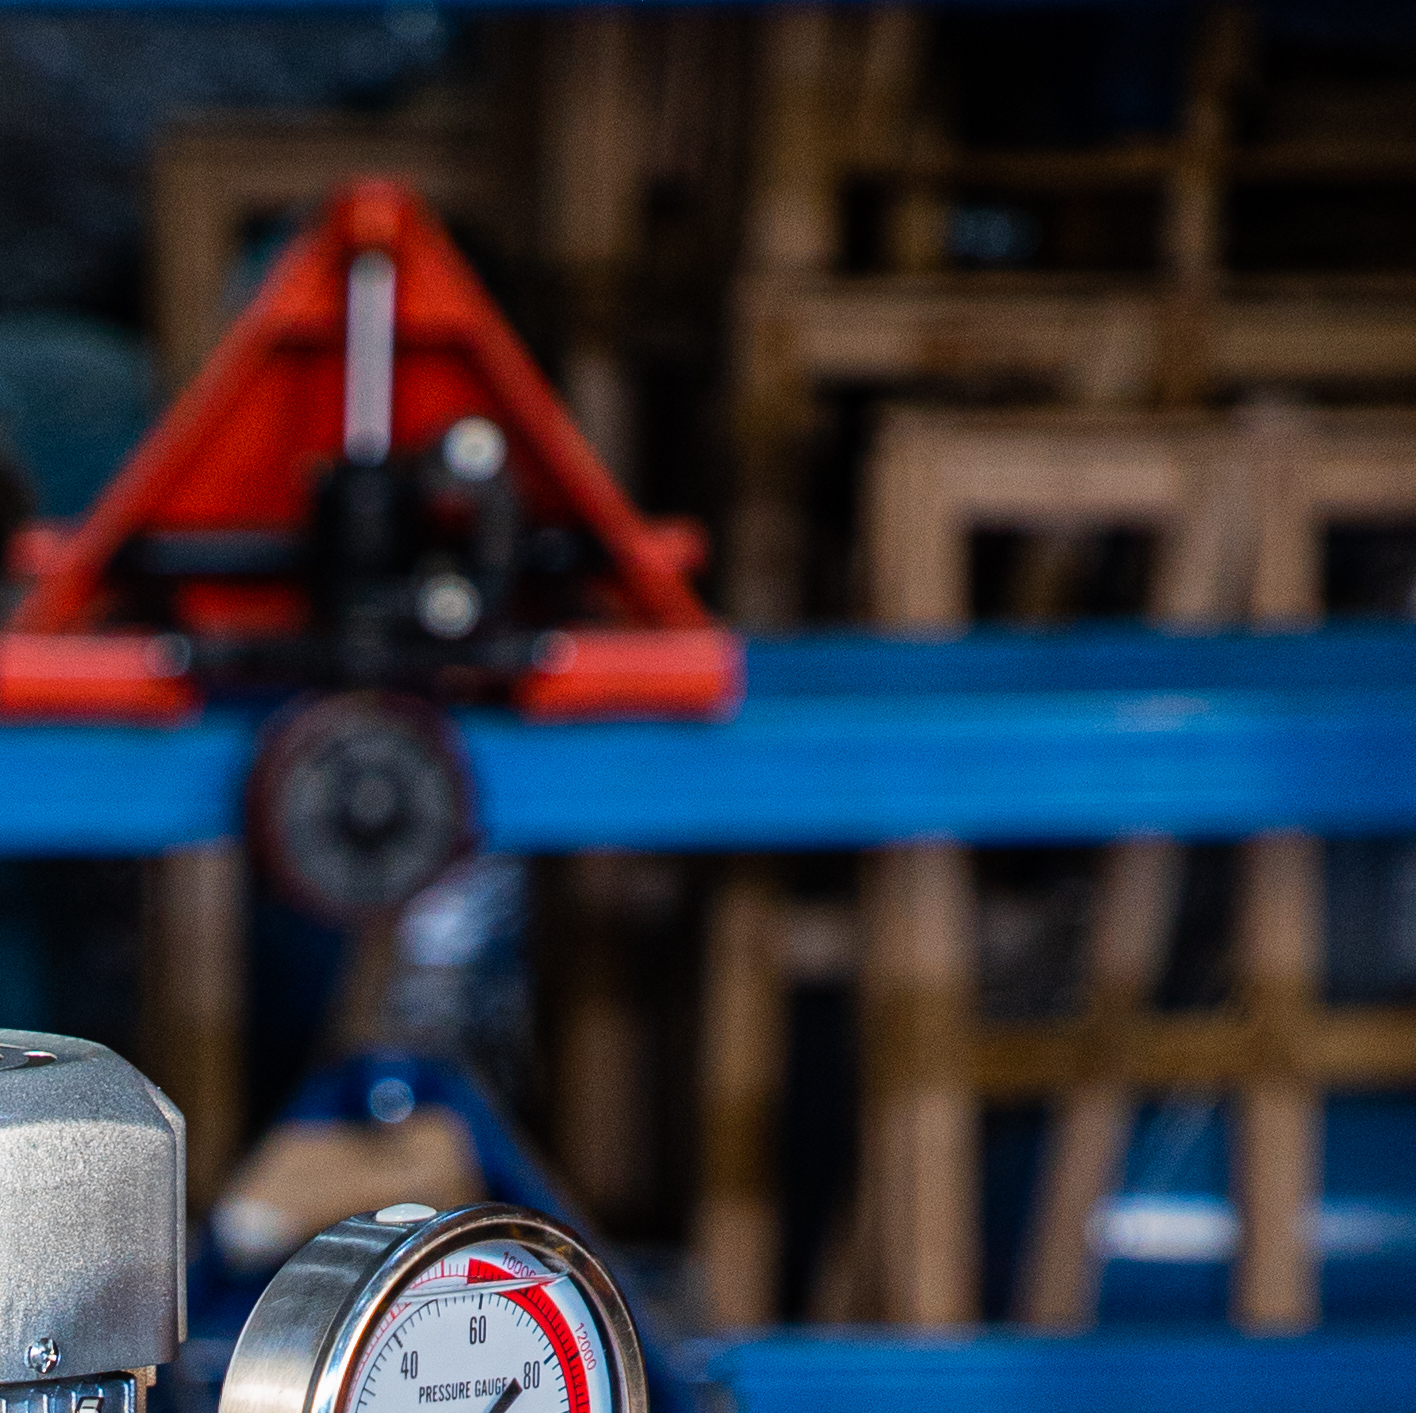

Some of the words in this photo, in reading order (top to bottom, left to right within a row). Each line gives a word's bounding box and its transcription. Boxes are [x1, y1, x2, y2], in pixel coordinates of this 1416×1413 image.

[469, 1315, 487, 1345] 60
[574, 1322, 597, 1371] 12000
[400, 1350, 419, 1380] 40
[523, 1360, 540, 1390] 80
[418, 1381, 471, 1404] PRESSURE
[475, 1377, 508, 1398] GAUGE
